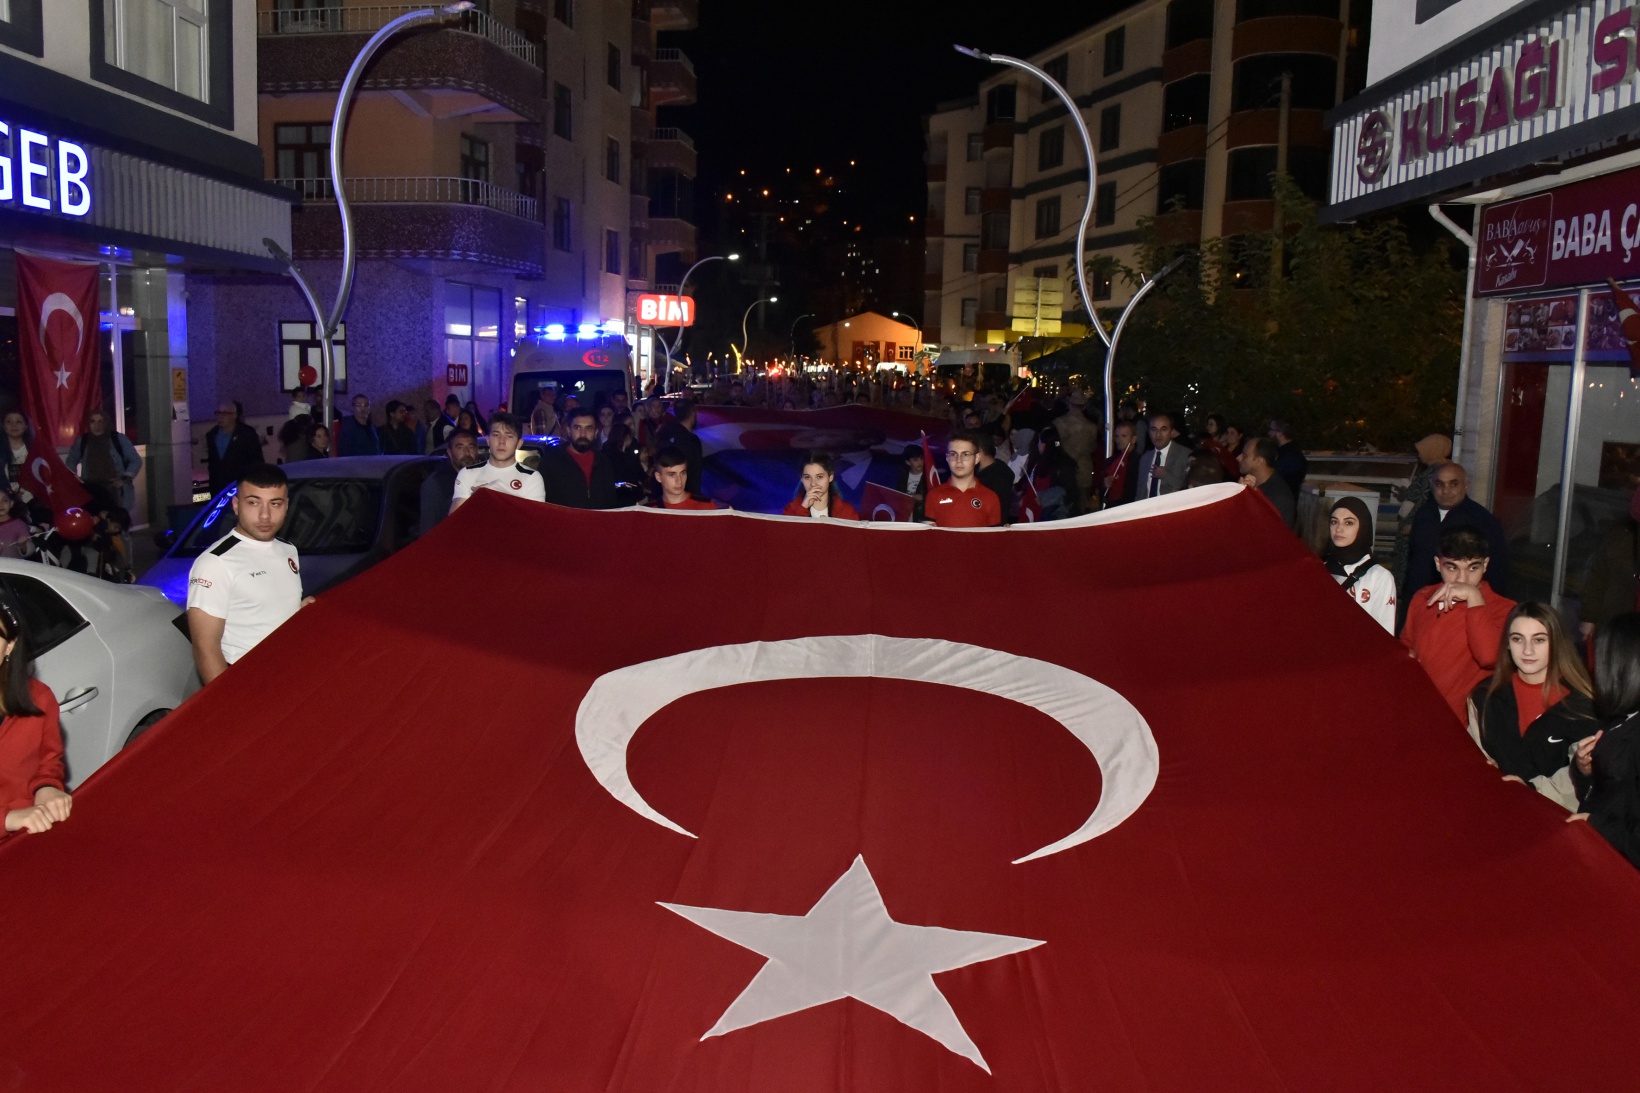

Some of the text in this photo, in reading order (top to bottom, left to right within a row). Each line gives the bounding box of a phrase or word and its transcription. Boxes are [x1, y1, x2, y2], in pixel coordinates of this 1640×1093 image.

[1592, 6, 1640, 94] S
[1551, 209, 1612, 261] BABA
[641, 295, 689, 322] BİM
